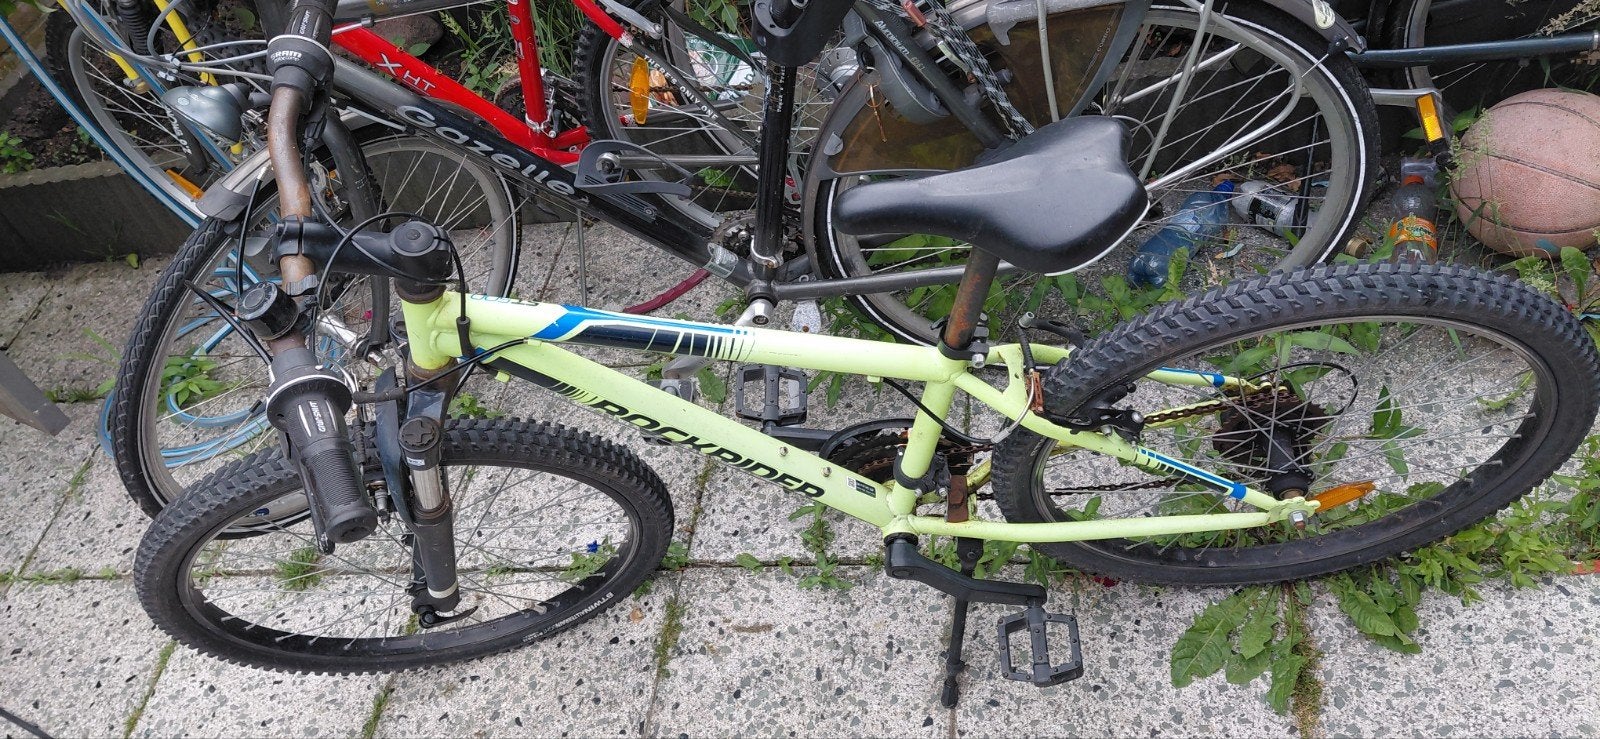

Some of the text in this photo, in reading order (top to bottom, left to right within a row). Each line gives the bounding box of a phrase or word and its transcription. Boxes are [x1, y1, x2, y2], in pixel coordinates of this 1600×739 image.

[270, 50, 303, 60] SRAM
[873, 20, 911, 56] Aluminium
[375, 53, 436, 91] X HT
[644, 54, 719, 120] THERE'S ONLY ONE
[397, 105, 576, 196] Gazelle
[592, 399, 826, 498] ROCKRIDER
